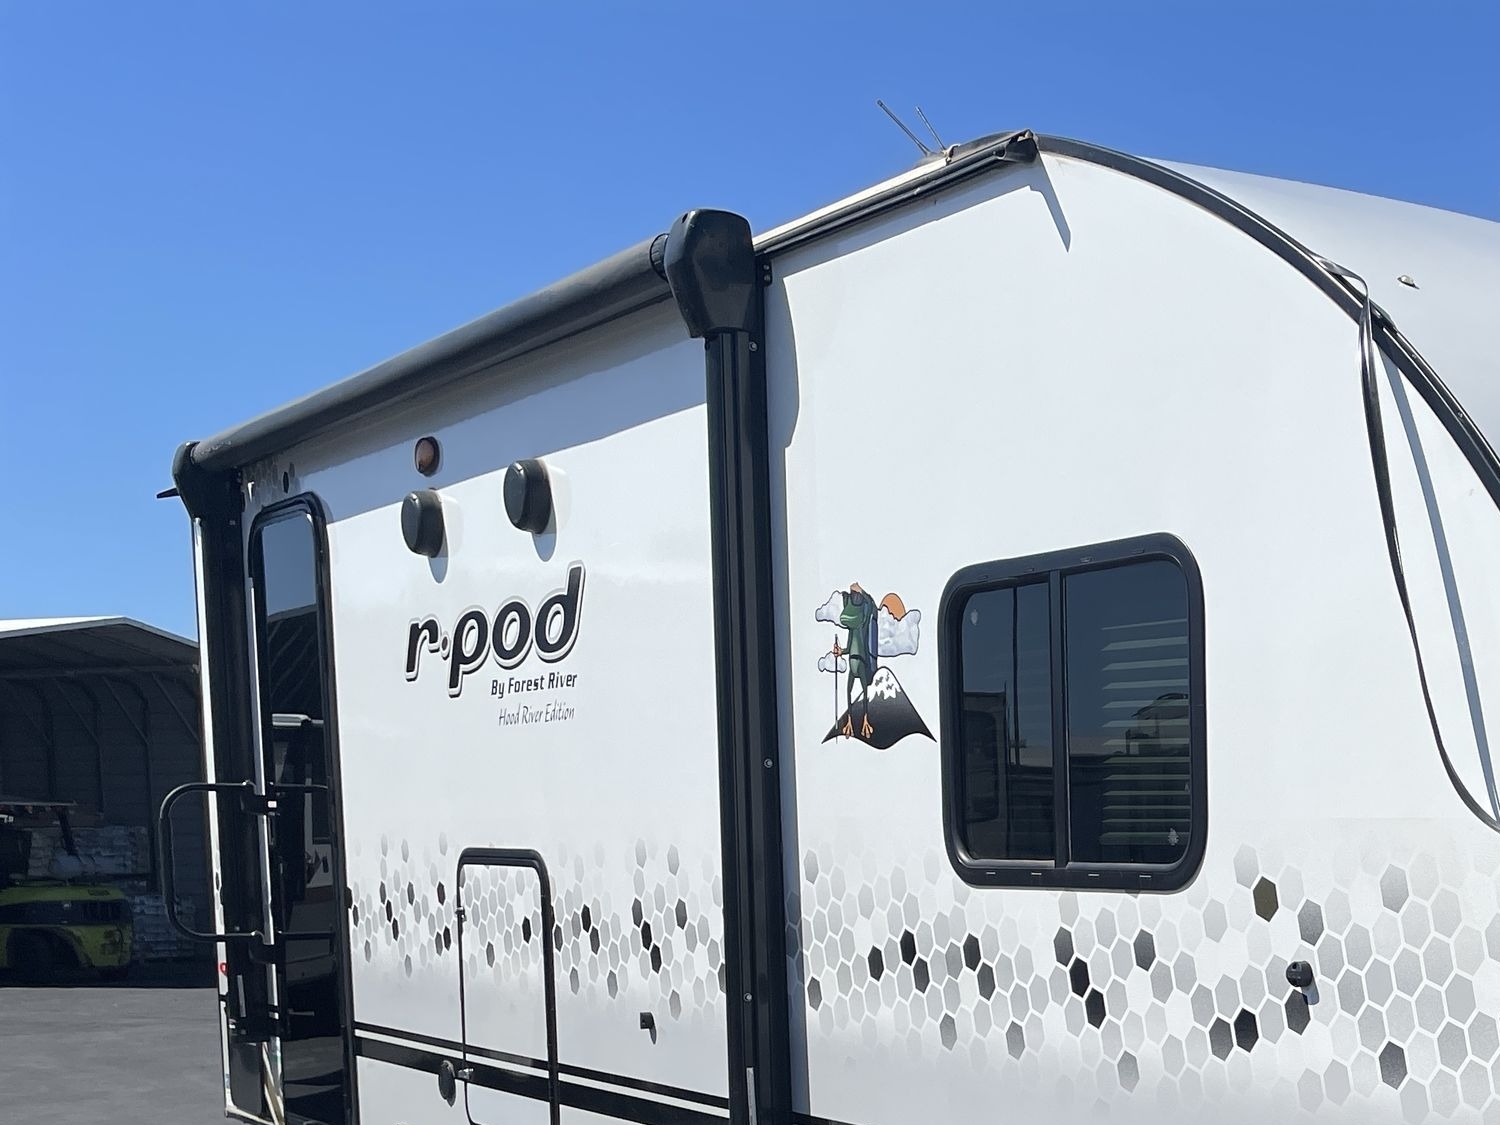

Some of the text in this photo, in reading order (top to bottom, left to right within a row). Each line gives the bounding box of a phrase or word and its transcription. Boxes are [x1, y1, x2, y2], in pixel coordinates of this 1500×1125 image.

[491, 671, 578, 700] By Forest River
[498, 700, 575, 726] Hood River Edition
